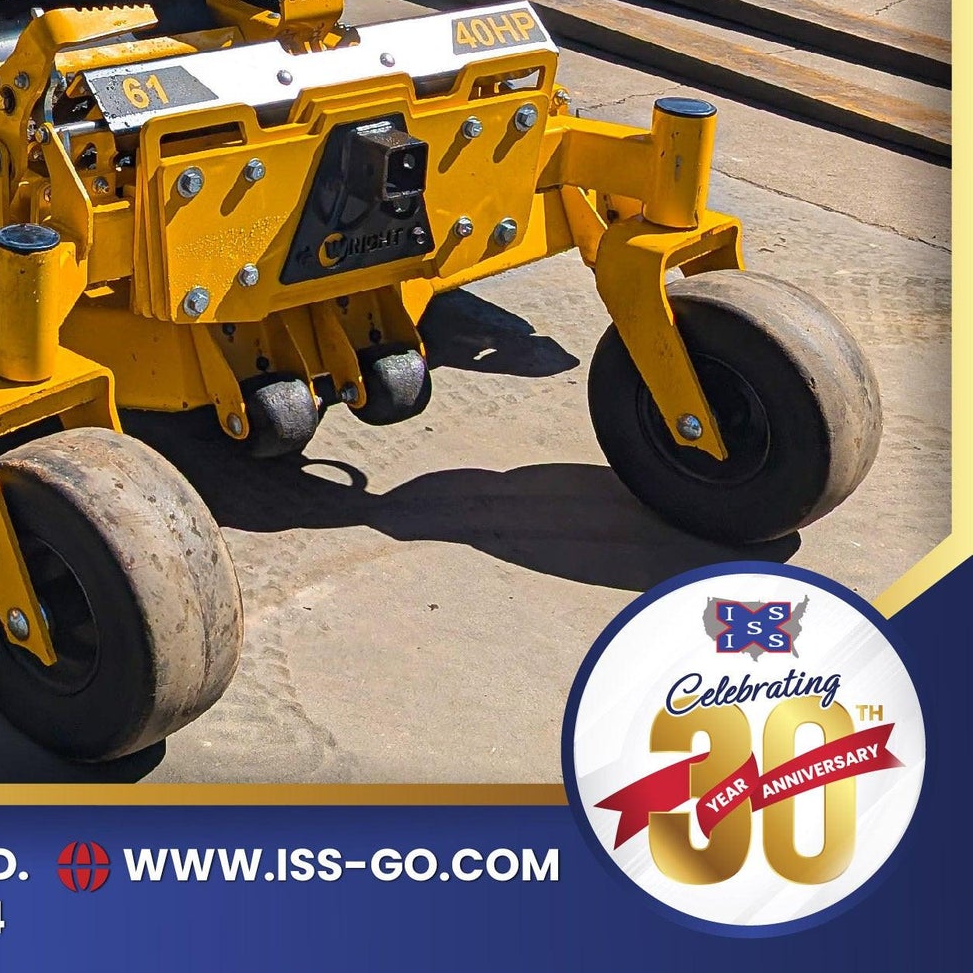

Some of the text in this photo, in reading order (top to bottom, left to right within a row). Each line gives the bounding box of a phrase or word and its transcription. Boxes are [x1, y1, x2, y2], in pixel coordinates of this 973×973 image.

[455, 6, 536, 49] 40HP
[120, 74, 169, 109] 61
[318, 228, 404, 267] WRIGHT
